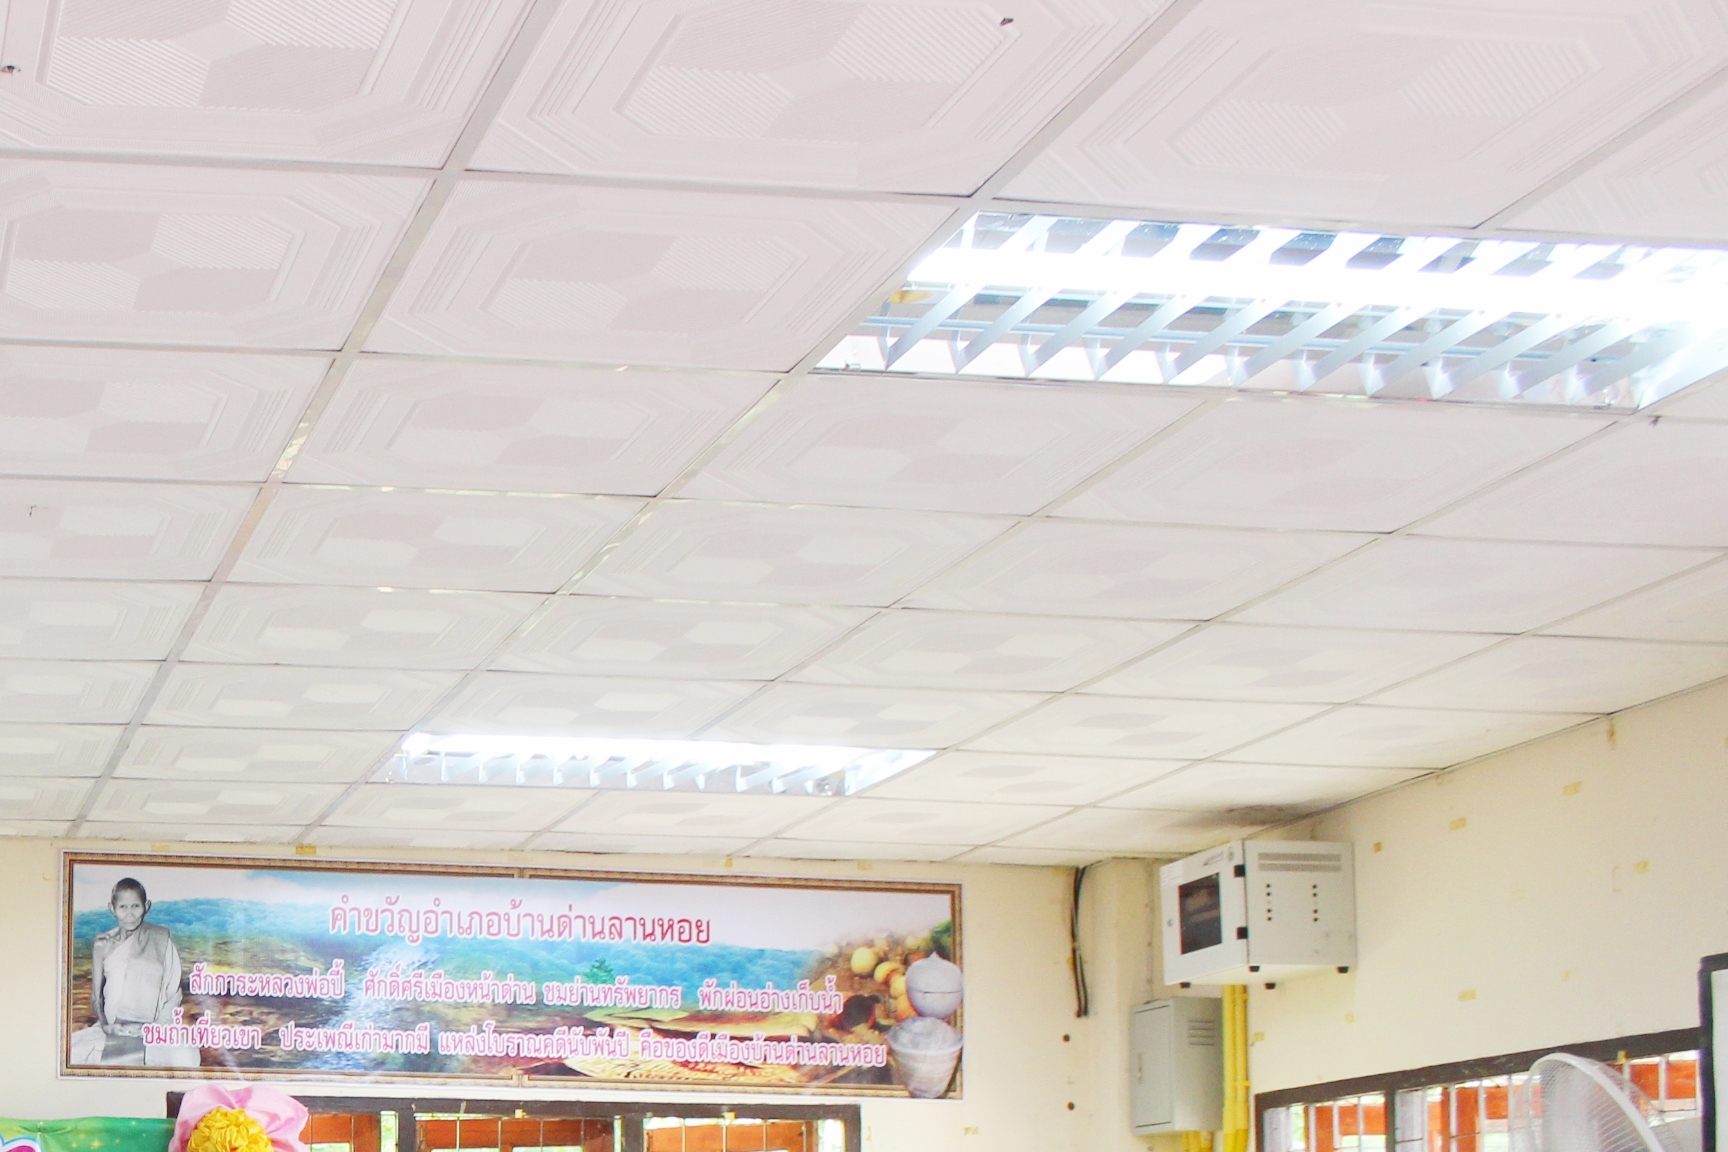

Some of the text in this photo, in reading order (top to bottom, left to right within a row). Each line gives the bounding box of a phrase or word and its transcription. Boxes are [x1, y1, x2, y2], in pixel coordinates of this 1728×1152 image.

[330, 895, 710, 944] คำขวัญอำเภอบ้านด่านลานหอย
[191, 960, 843, 1012] สักการะหลวงพ่อปี้ ศักดิ์ศรีเมืองหน้าด่าน ชมย่านทรัพยากร พักผ่อนอ่างเก็บน้ำ
[143, 1009, 886, 1065] ชมถ้ำเที่ยวเขา ประเพณีเก่ามากมี แหล่งโบราณคดีนับพันปี คือของดีเมืองบ้านด่านลานหอย
